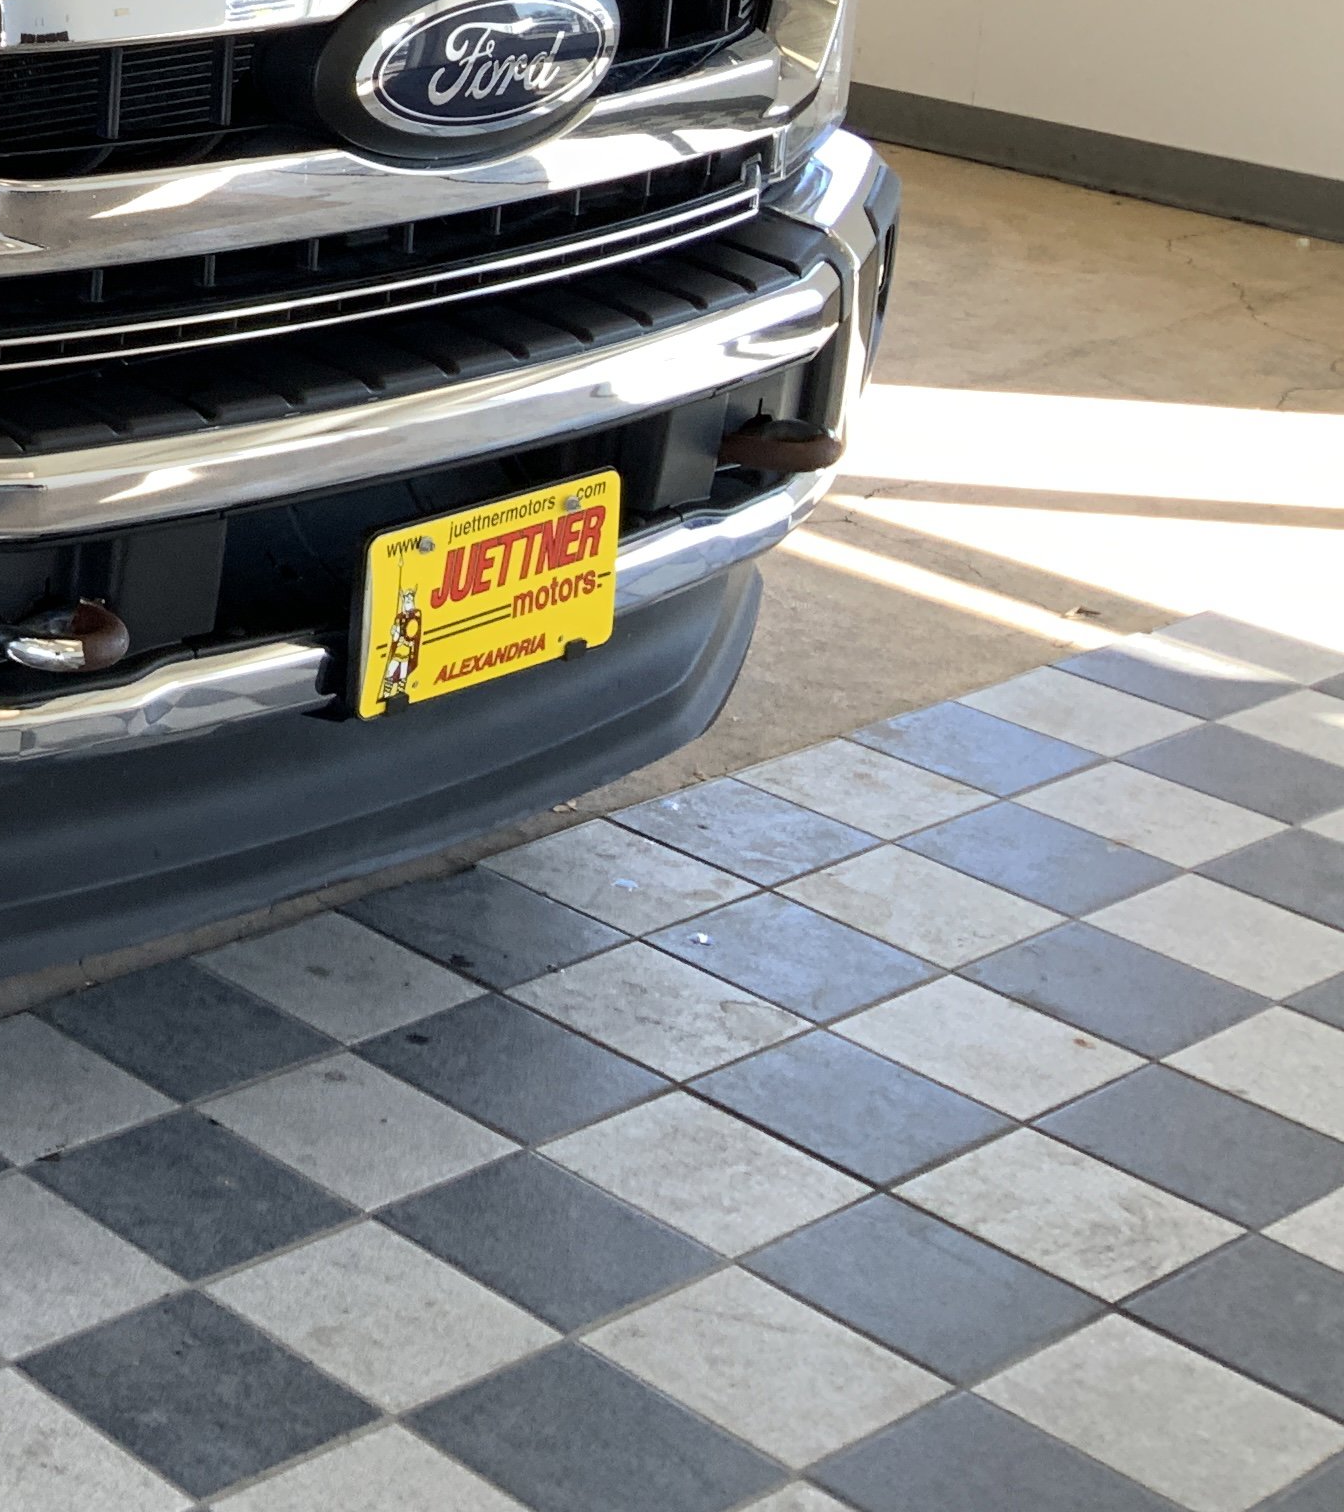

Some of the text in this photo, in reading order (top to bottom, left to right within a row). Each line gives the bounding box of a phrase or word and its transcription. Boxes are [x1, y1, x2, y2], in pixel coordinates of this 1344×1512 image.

[428, 19, 566, 106] Ford
[430, 505, 606, 609] JUETTNER
[512, 569, 598, 618] motors
[433, 633, 546, 686] ALEXANDRIA
